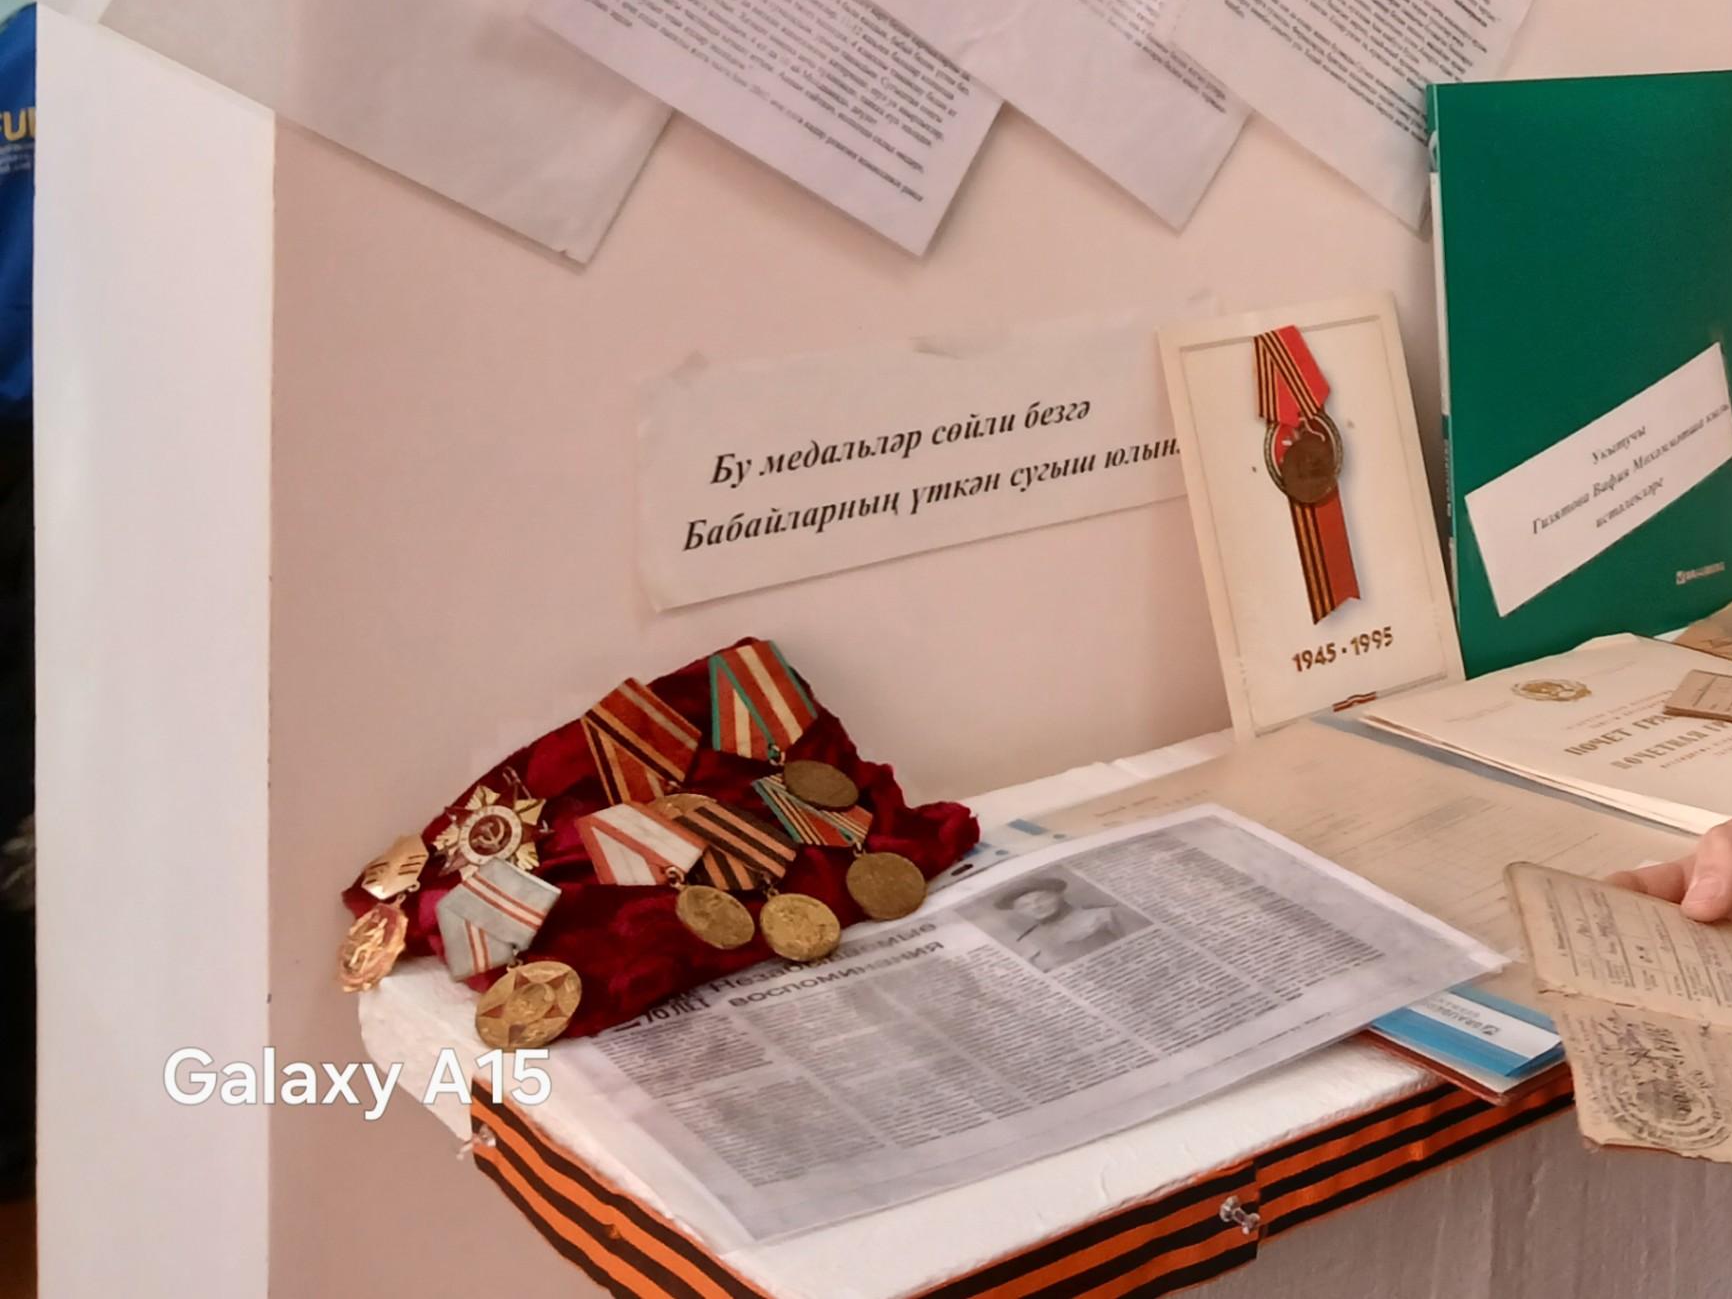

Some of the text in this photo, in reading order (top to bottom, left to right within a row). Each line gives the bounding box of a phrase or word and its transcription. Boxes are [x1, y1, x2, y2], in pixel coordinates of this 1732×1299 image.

[710, 399, 1091, 490] Бу медальләр сөйли безгә
[682, 487, 901, 553] Бабайларның
[909, 473, 1001, 515] үткән
[1009, 453, 1096, 491] сугыш
[1291, 642, 1337, 673] 1945
[1350, 625, 1393, 656] 1995
